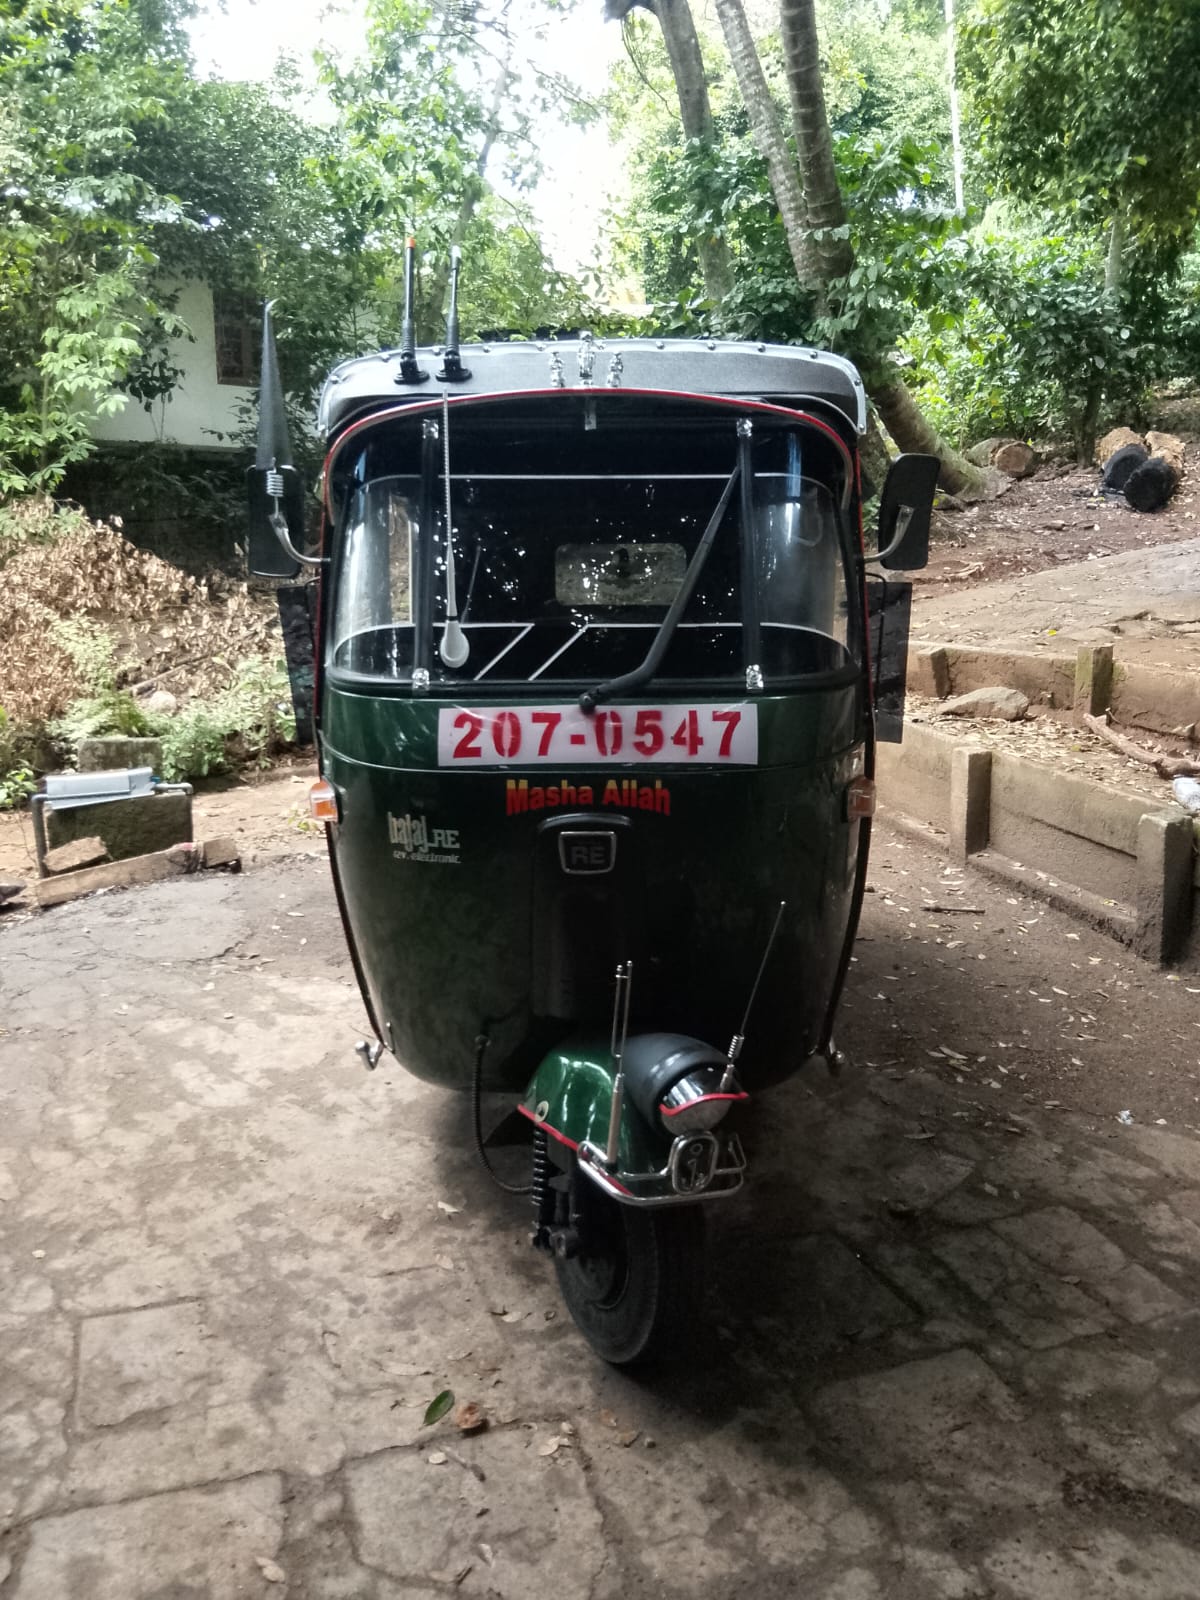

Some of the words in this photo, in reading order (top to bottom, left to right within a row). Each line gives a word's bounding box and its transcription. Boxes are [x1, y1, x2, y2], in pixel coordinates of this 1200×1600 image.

[452, 709, 742, 758] 207-0547
[506, 779, 593, 815] Masha
[602, 779, 671, 815] Allah
[387, 811, 429, 853] bajaj
[429, 828, 460, 849] RE
[570, 846, 605, 865] RE
